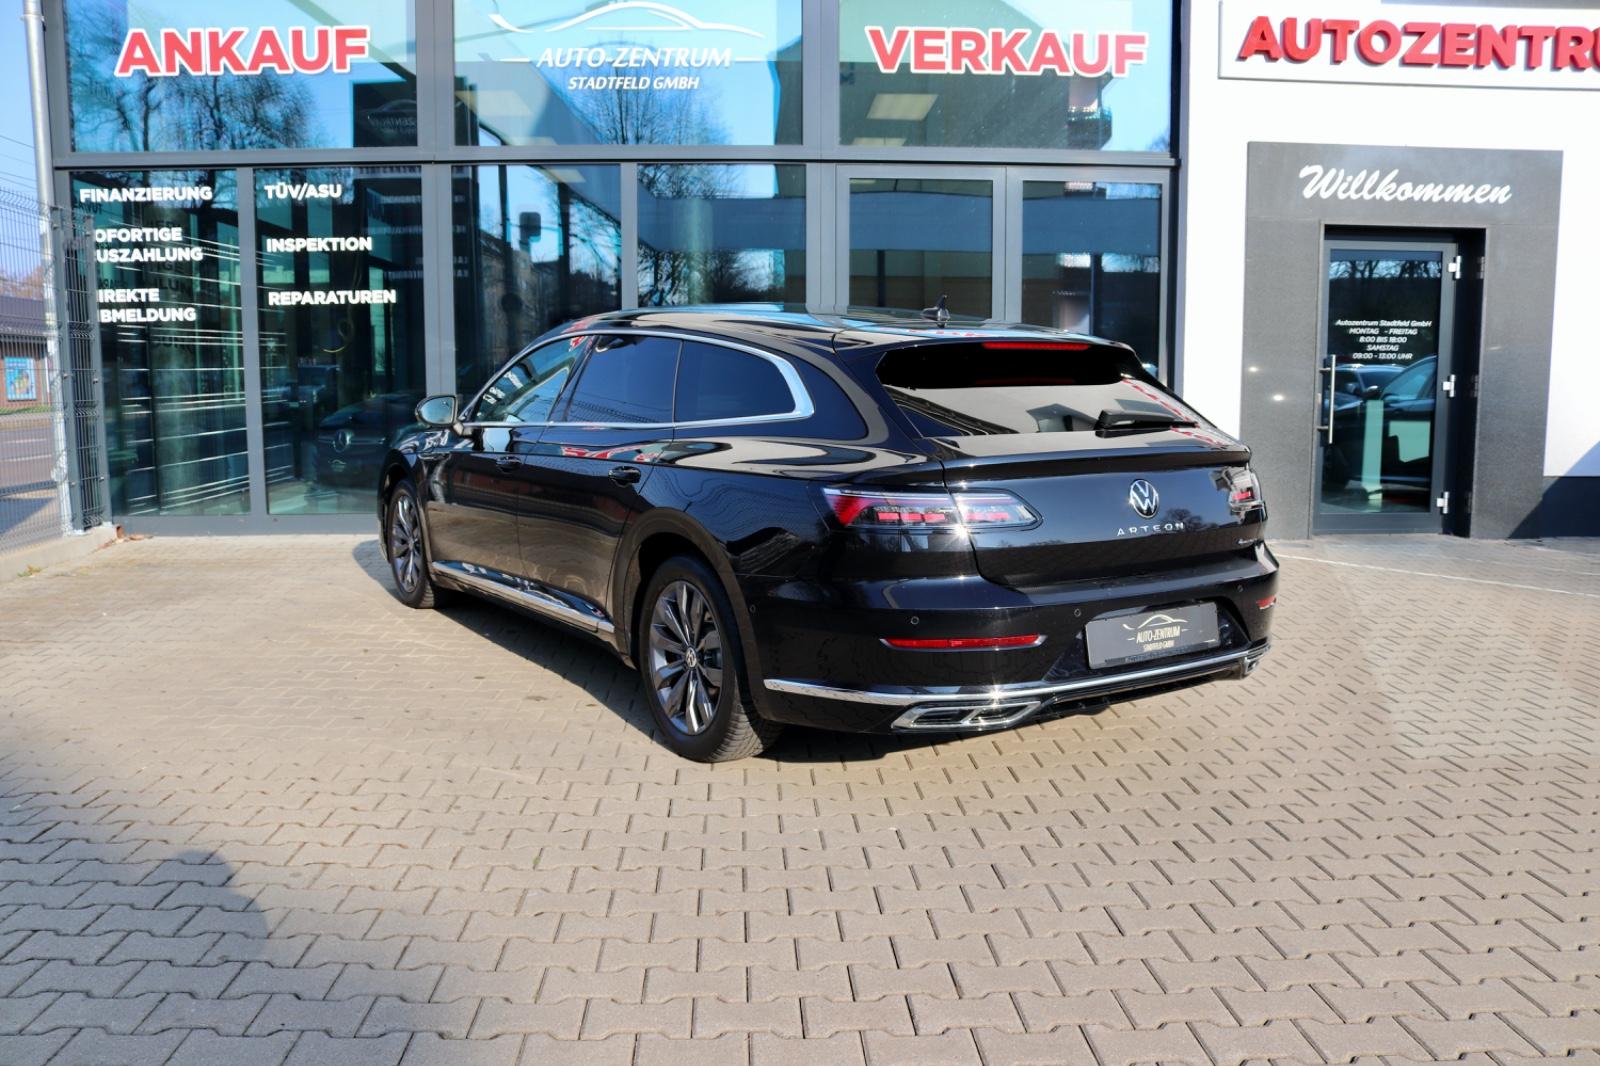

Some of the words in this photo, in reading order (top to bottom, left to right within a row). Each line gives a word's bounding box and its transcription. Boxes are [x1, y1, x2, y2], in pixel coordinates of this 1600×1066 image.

[115, 25, 370, 76] ANKAUF
[536, 47, 732, 69] AUTO-ZENTRUM
[864, 26, 1150, 78] VERKAUF
[567, 76, 651, 91] STADTFELD
[653, 76, 700, 90] GMBH
[264, 182, 343, 201] TÜV/ASU
[1299, 164, 1512, 205] Willkommen
[79, 186, 213, 203] FINANZIERUNG
[95, 227, 184, 243] OFORTIGE
[266, 236, 373, 253] INSPEKTION
[95, 247, 204, 263] USZAHLUNG
[97, 288, 161, 304] IREKTE
[268, 289, 398, 306] REPARATUREN
[97, 307, 198, 323] BMELDUNG
[1116, 521, 1184, 537] ARTEON
